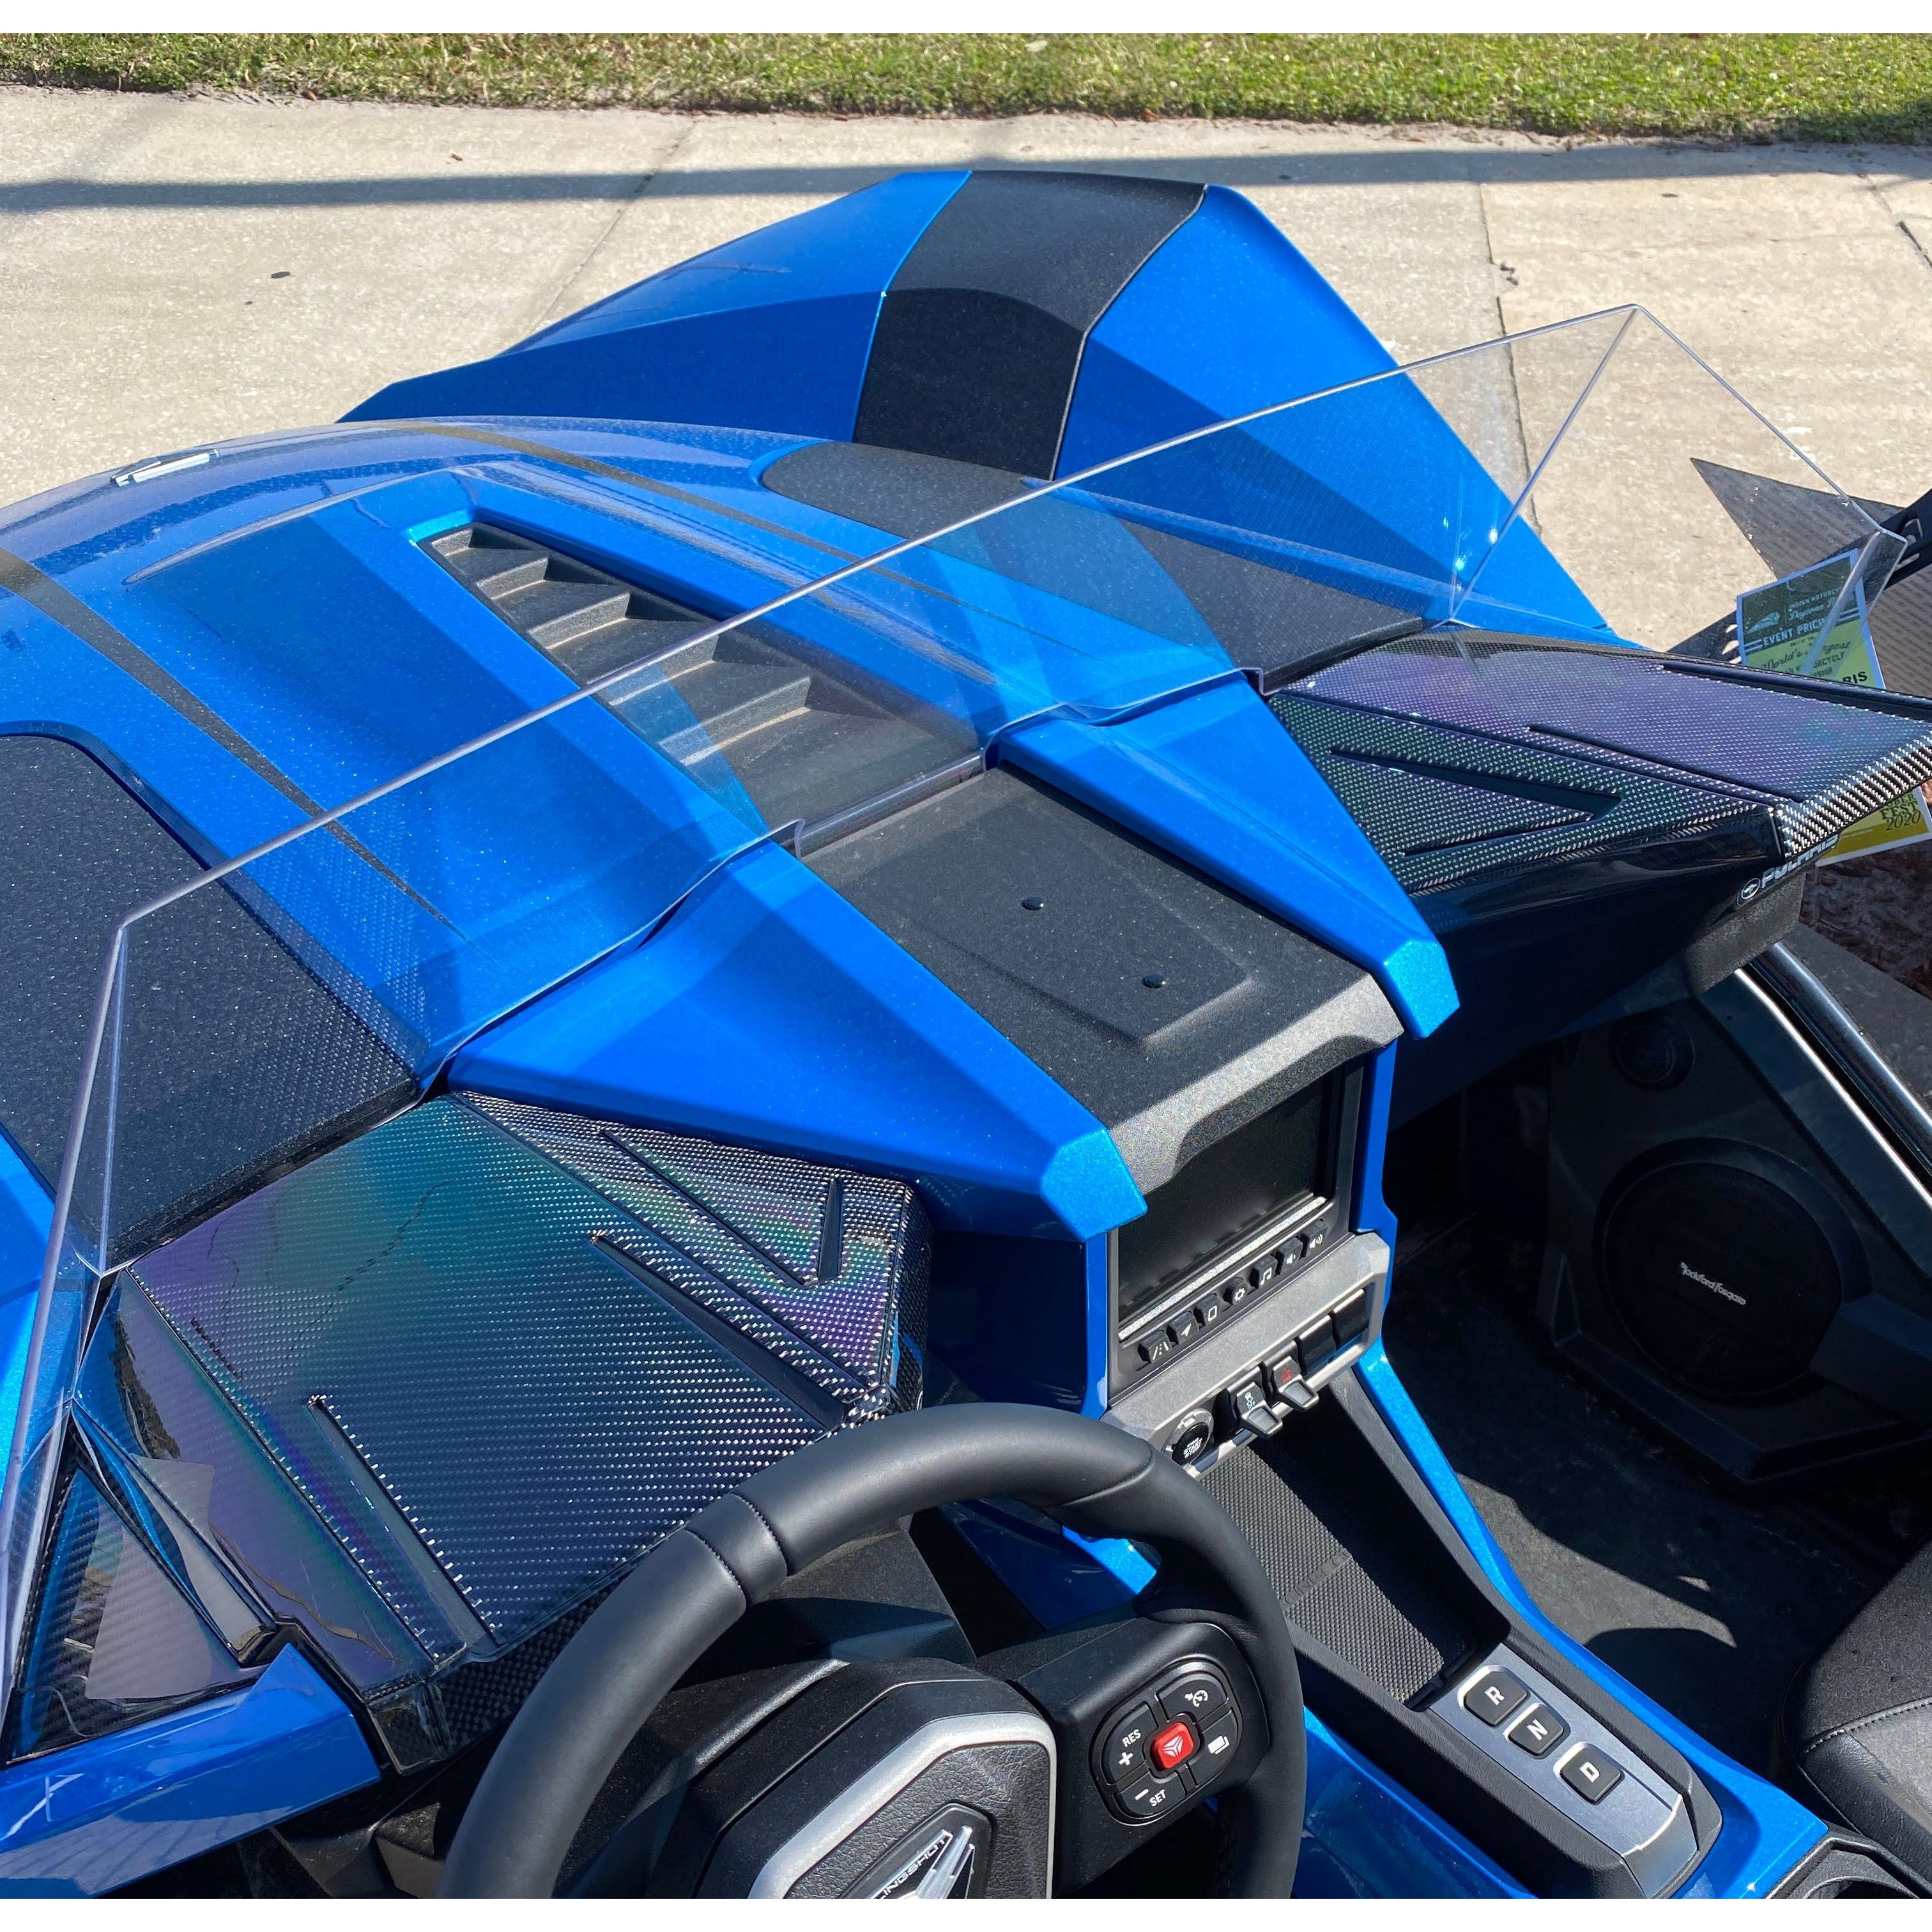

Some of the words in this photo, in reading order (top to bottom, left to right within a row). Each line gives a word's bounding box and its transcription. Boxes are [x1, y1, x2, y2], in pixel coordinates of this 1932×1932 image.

[1763, 628, 1793, 646] EVENT
[1879, 801, 1919, 820] FEST
[1885, 811, 1921, 831] 2020
[1483, 1685, 1505, 1706] R
[1122, 1729, 1142, 1747] RES
[1526, 1719, 1549, 1741] N
[1579, 1761, 1600, 1783] D
[1149, 1789, 1167, 1807] SET
